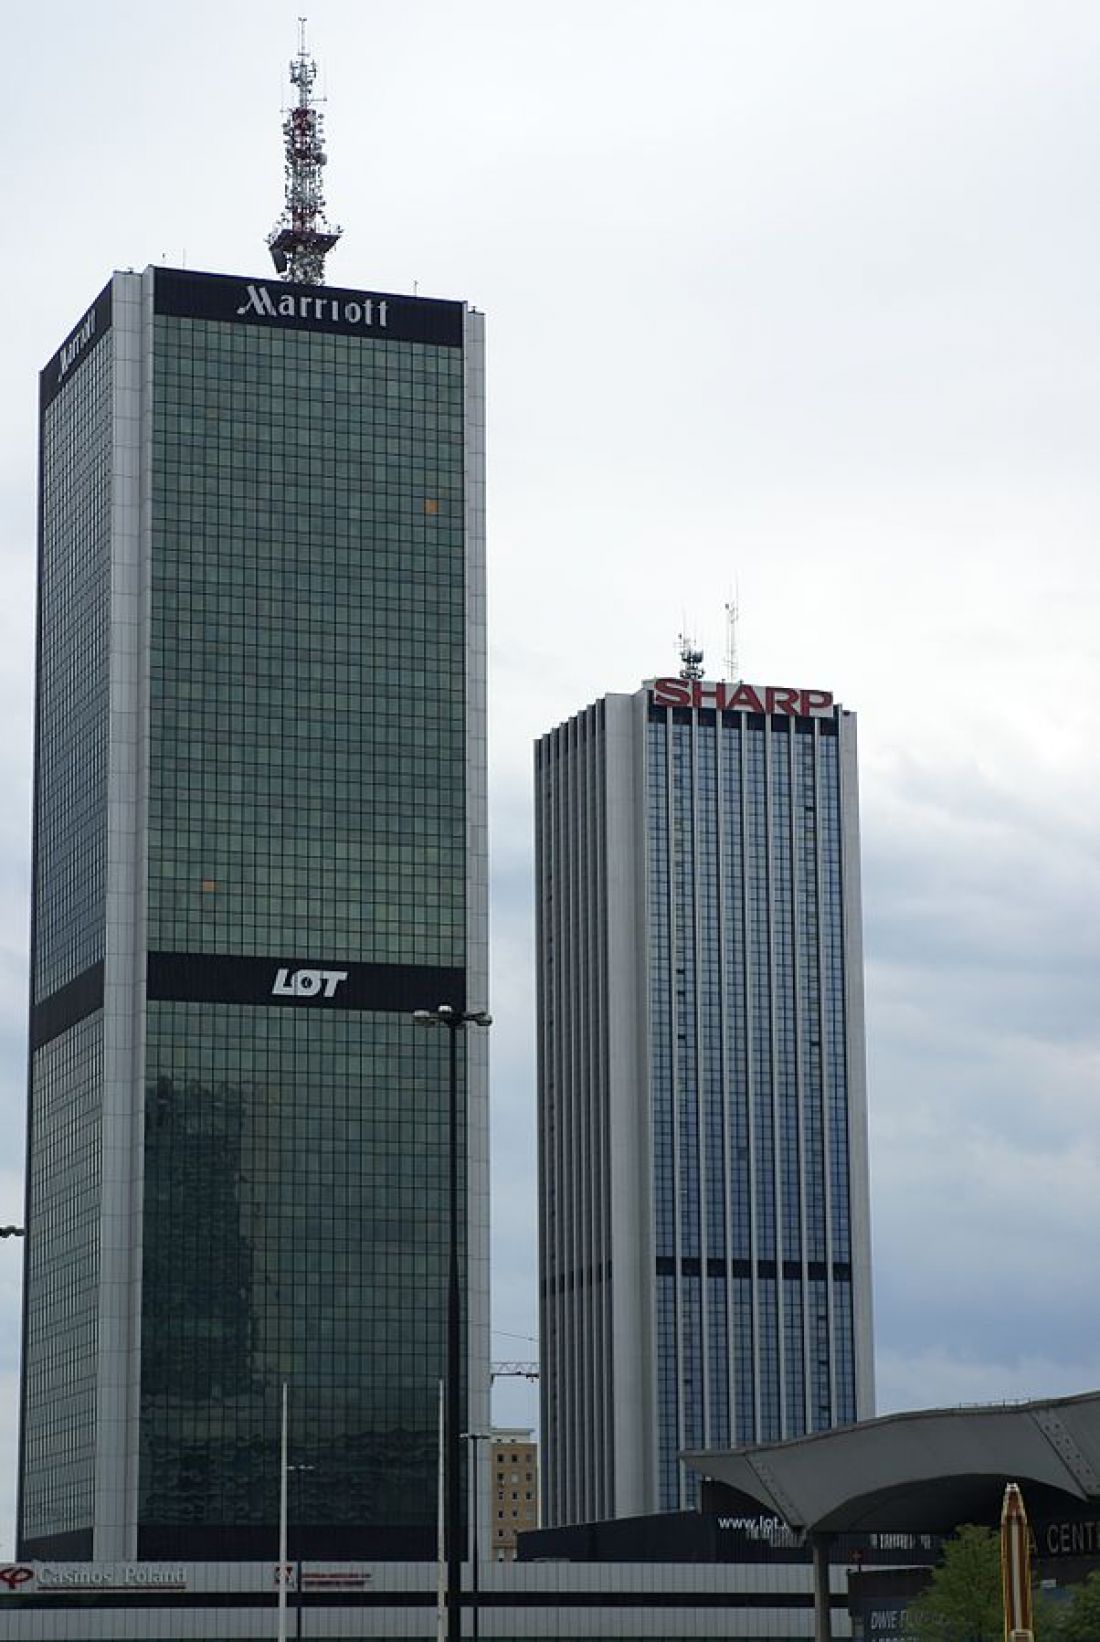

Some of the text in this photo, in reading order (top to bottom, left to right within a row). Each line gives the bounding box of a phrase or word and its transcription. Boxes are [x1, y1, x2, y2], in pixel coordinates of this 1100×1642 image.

[236, 285, 389, 327] Marriott
[655, 679, 833, 717] SHARP
[272, 968, 348, 997] LOT
[1047, 1521, 1100, 1553] CENT
[38, 1565, 186, 1584] Casinos Poland
